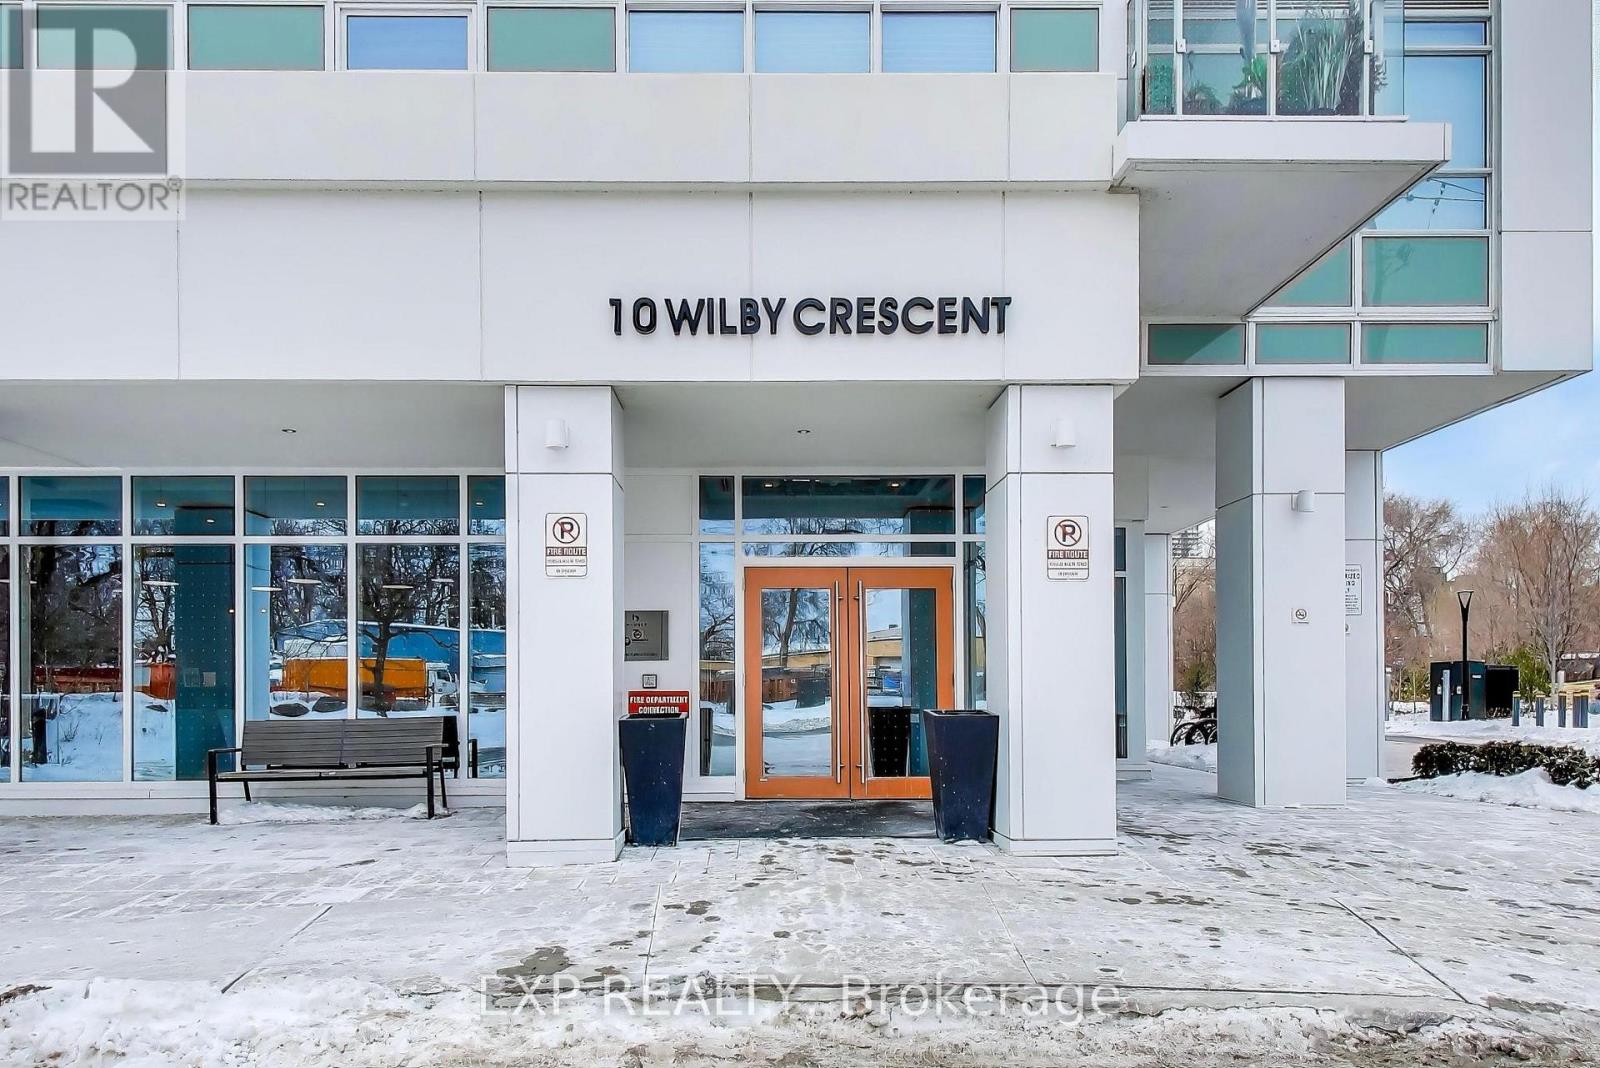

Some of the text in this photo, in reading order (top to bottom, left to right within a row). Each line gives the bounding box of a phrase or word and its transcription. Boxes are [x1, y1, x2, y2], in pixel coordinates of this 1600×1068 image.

[609, 296, 1013, 336] 10 WILBY CRESCENT
[629, 696, 688, 704] FIRE DEPARTMENT
[638, 706, 680, 714] CONNECTION
